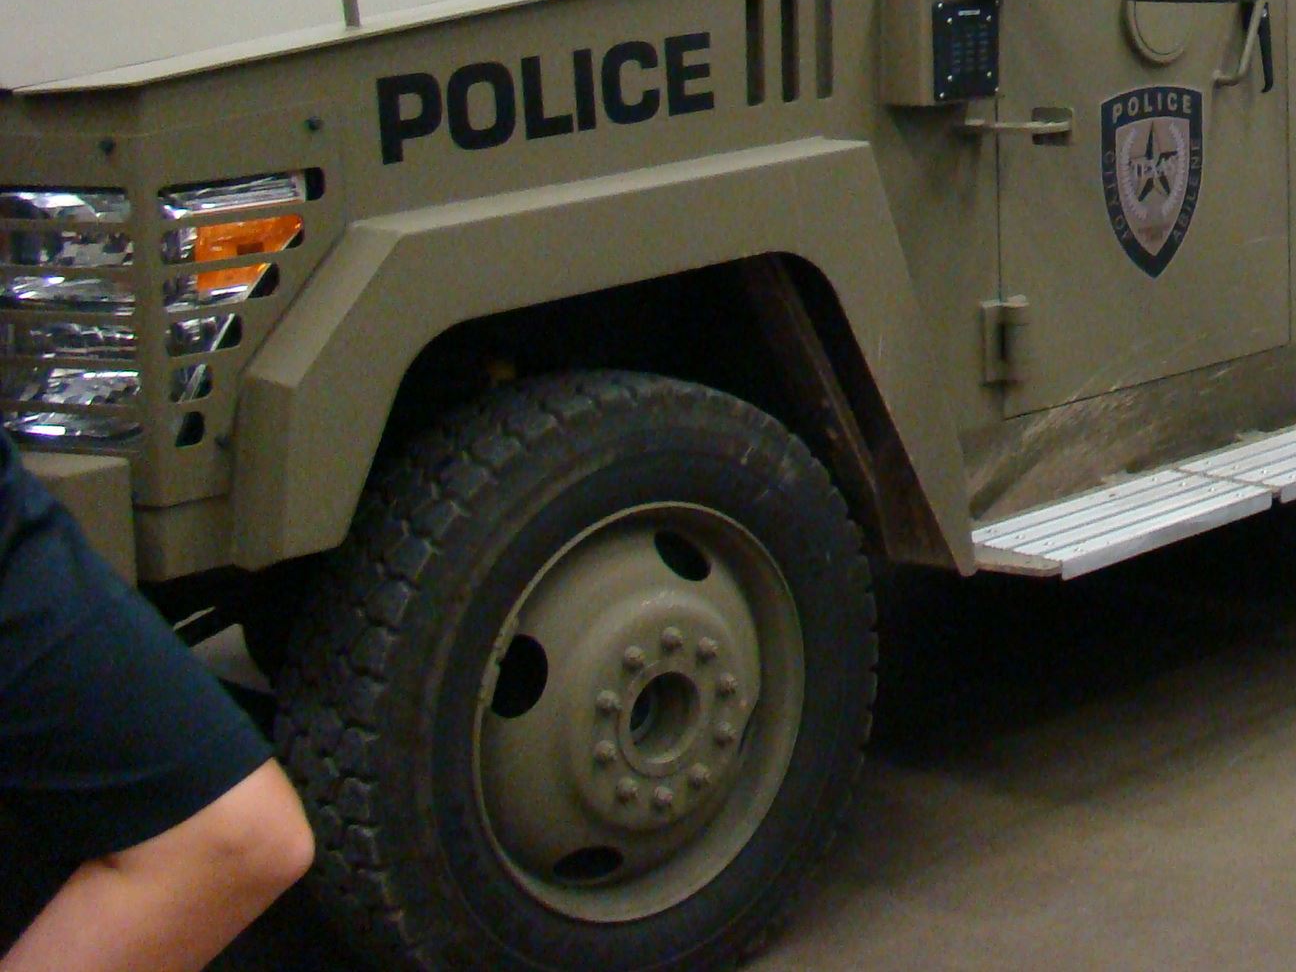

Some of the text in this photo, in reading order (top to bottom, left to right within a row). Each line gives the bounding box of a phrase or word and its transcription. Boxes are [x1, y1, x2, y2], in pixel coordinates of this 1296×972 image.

[376, 32, 715, 166] POLICE
[1112, 92, 1193, 124] POLICE
[1103, 151, 1120, 207] CITY
[1173, 137, 1202, 243] ABILENE
